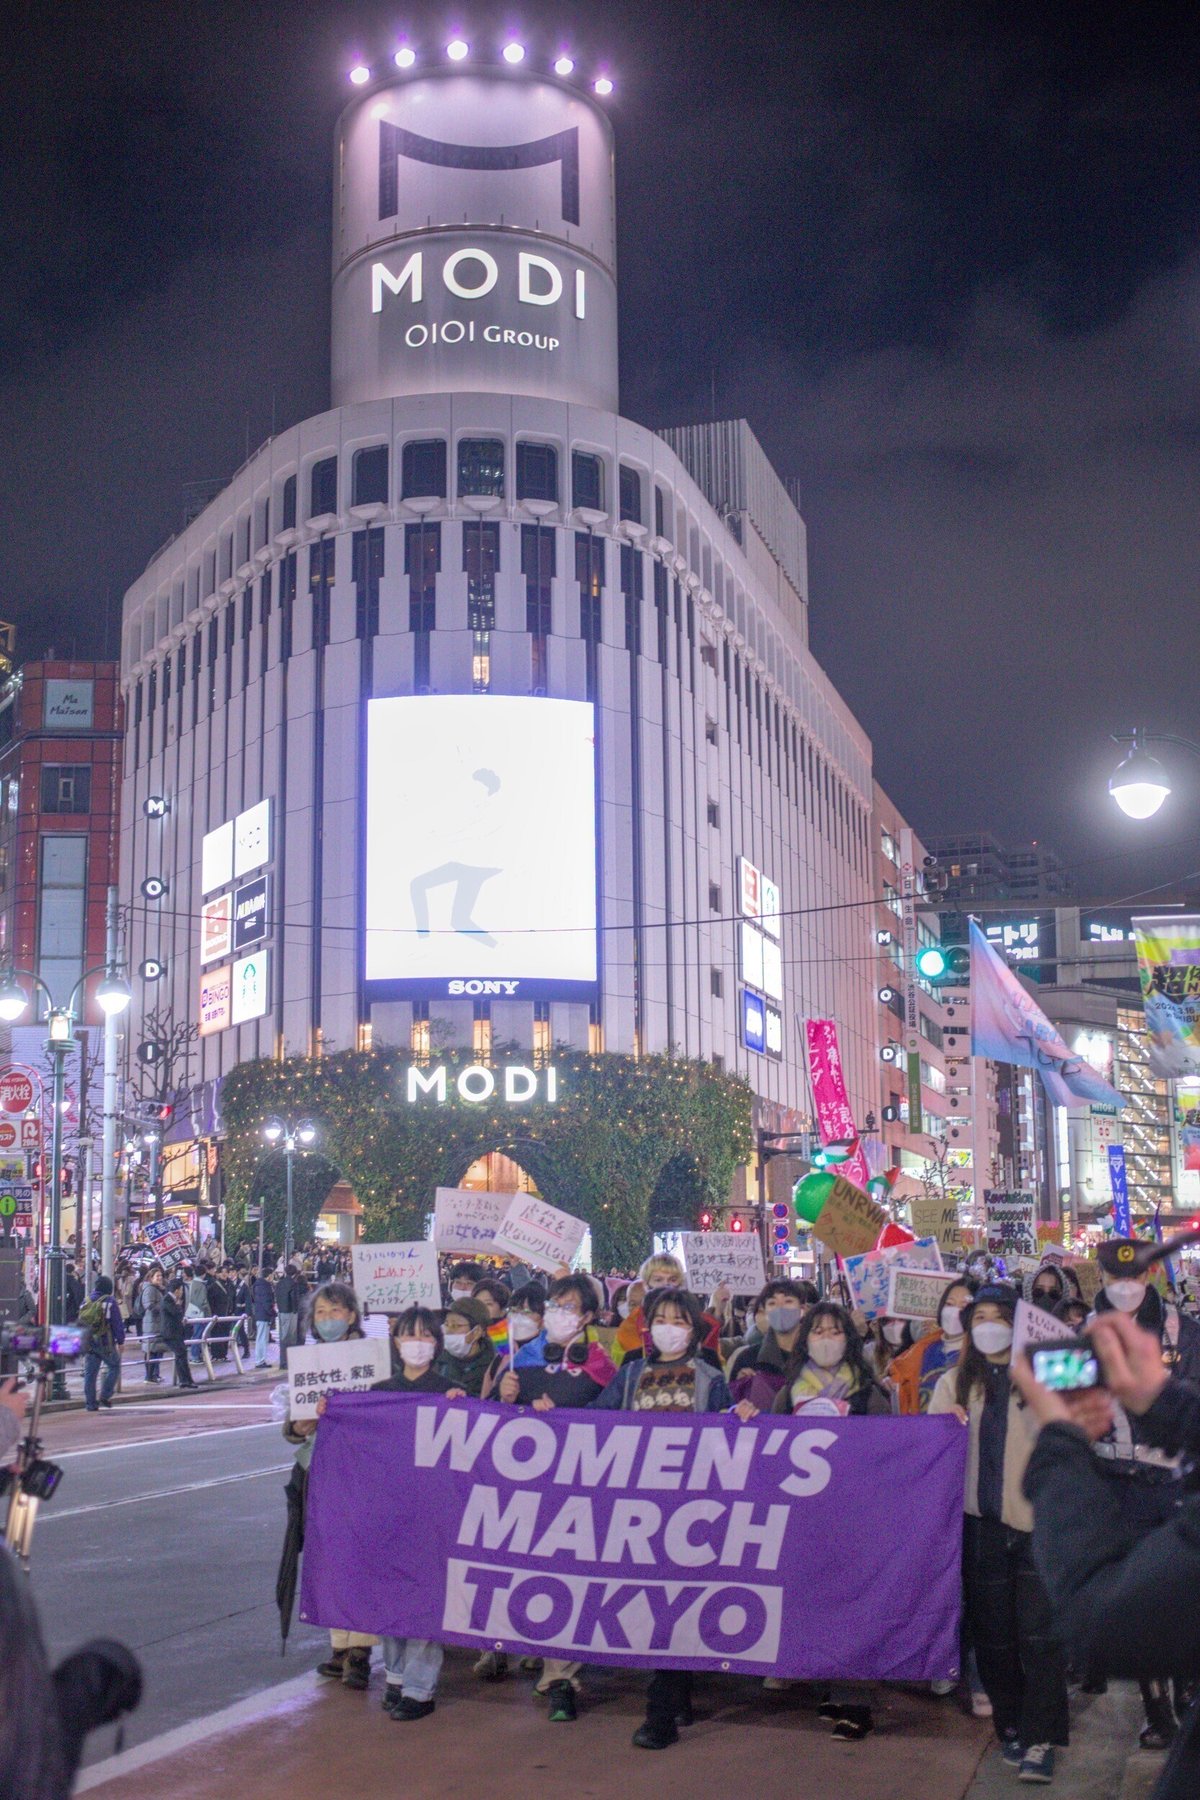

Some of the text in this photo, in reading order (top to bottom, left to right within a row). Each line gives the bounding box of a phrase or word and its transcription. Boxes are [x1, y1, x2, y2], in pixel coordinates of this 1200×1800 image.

[371, 248, 585, 320] MODI
[483, 325, 560, 351] GROUP
[49, 705, 88, 715] Maison
[62, 694, 78, 704] Ma
[986, 922, 1038, 946] ニトリ
[208, 986, 230, 1006] BINGO
[448, 979, 520, 995] SONY
[0, 1084, 31, 1102] 消火栓
[407, 1065, 557, 1102] MODI
[914, 1207, 959, 1225] SEE ME
[1114, 1178, 1128, 1231] YWCA
[943, 1228, 961, 1244] ME
[414, 1406, 838, 1497] WOMEN'S
[456, 1484, 791, 1571] MARCH
[462, 1567, 768, 1655] TOKYO
